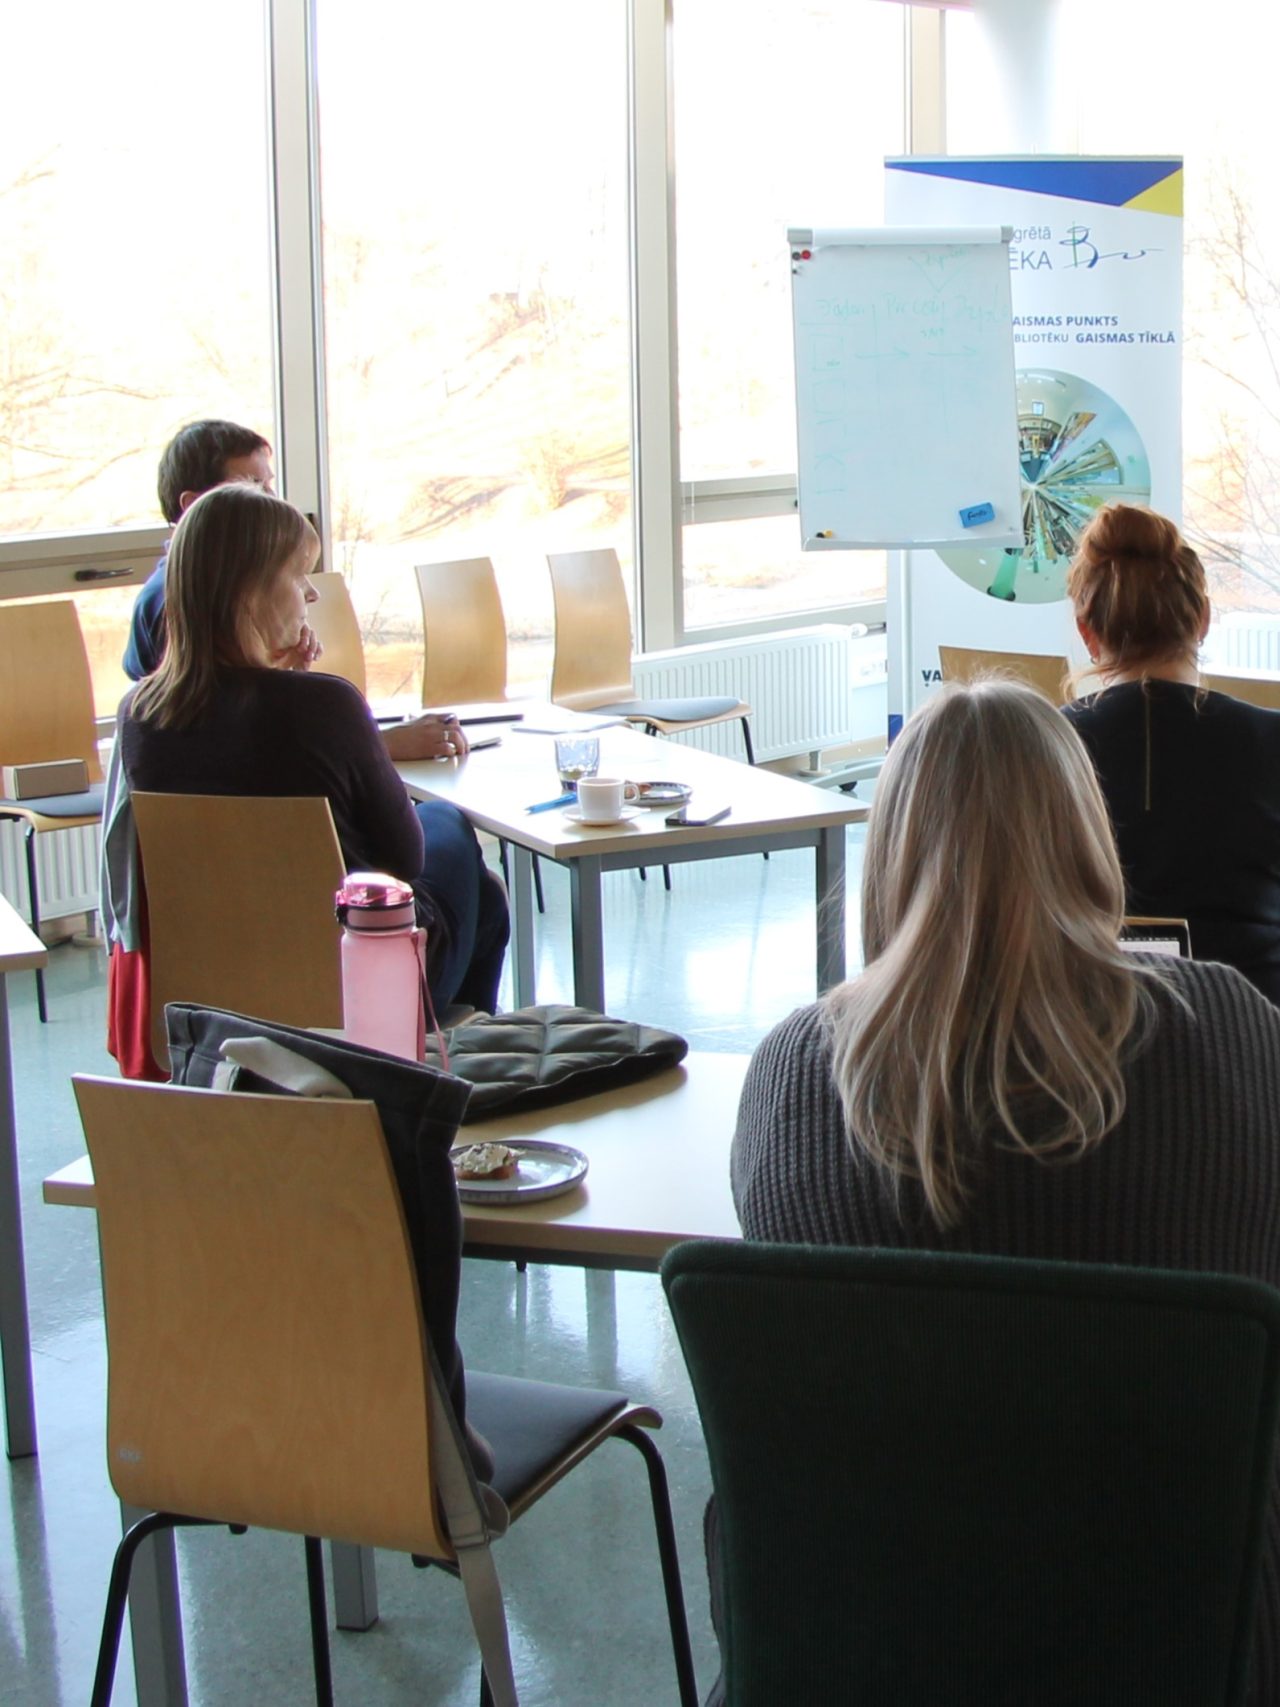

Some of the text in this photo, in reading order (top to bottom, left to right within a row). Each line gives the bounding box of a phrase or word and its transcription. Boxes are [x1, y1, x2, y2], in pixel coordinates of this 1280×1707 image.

[1012, 226, 1052, 243] grētā
[1009, 246, 1053, 270] ĒKA
[1012, 315, 1119, 327] AISMAS PUNKTS
[1014, 330, 1176, 344] BLIOTĒKU GAISMAS TĪKLĀ
[922, 670, 943, 687] VA
